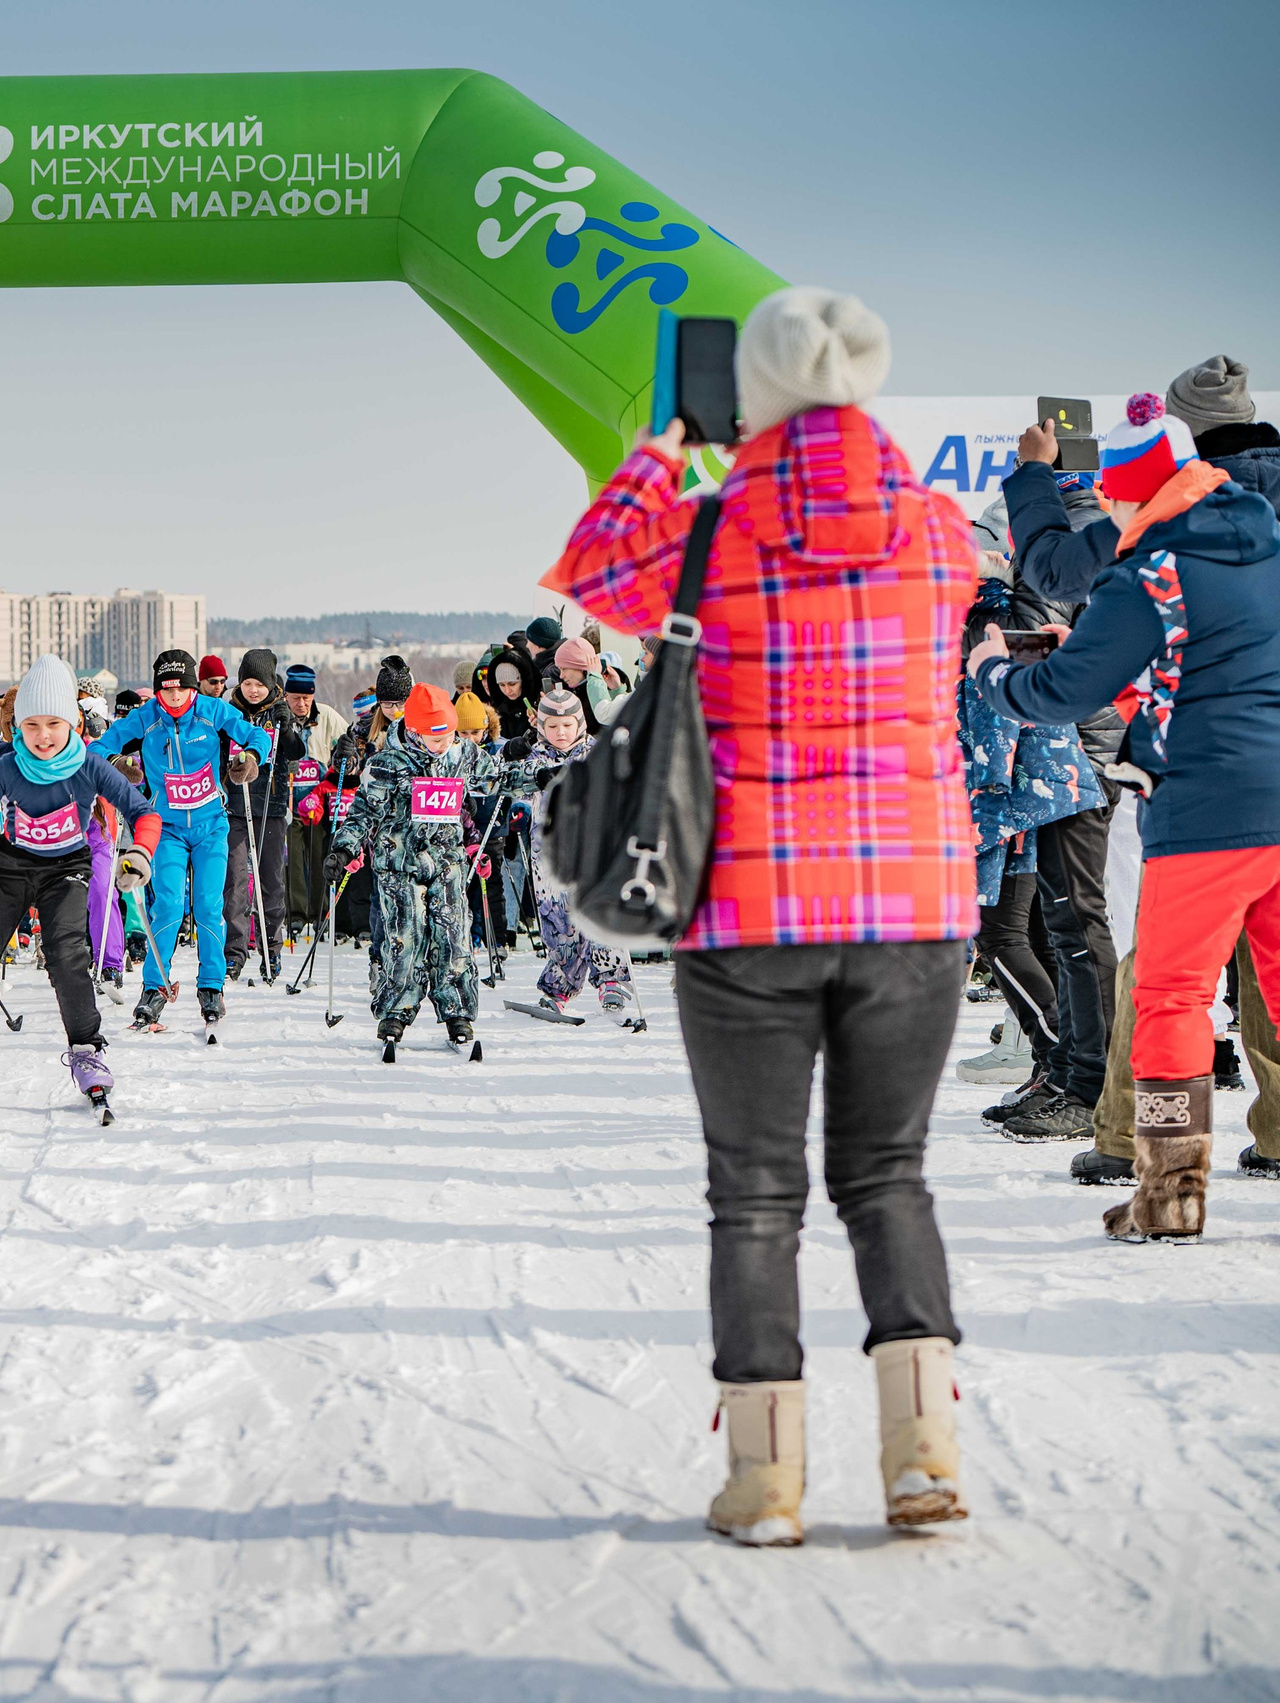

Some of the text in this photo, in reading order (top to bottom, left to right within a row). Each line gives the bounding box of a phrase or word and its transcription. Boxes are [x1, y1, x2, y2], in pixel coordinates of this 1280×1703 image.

[31, 115, 264, 150] ИРКУТСКИЙ
[31, 146, 401, 189] МЕЖДУНАРОДНЫЙ
[31, 189, 368, 220] СЛАТА МАРАФОН
[295, 767, 318, 779] 049
[169, 777, 212, 799] 1028
[417, 791, 457, 809] 1474
[18, 816, 76, 840] 2054
